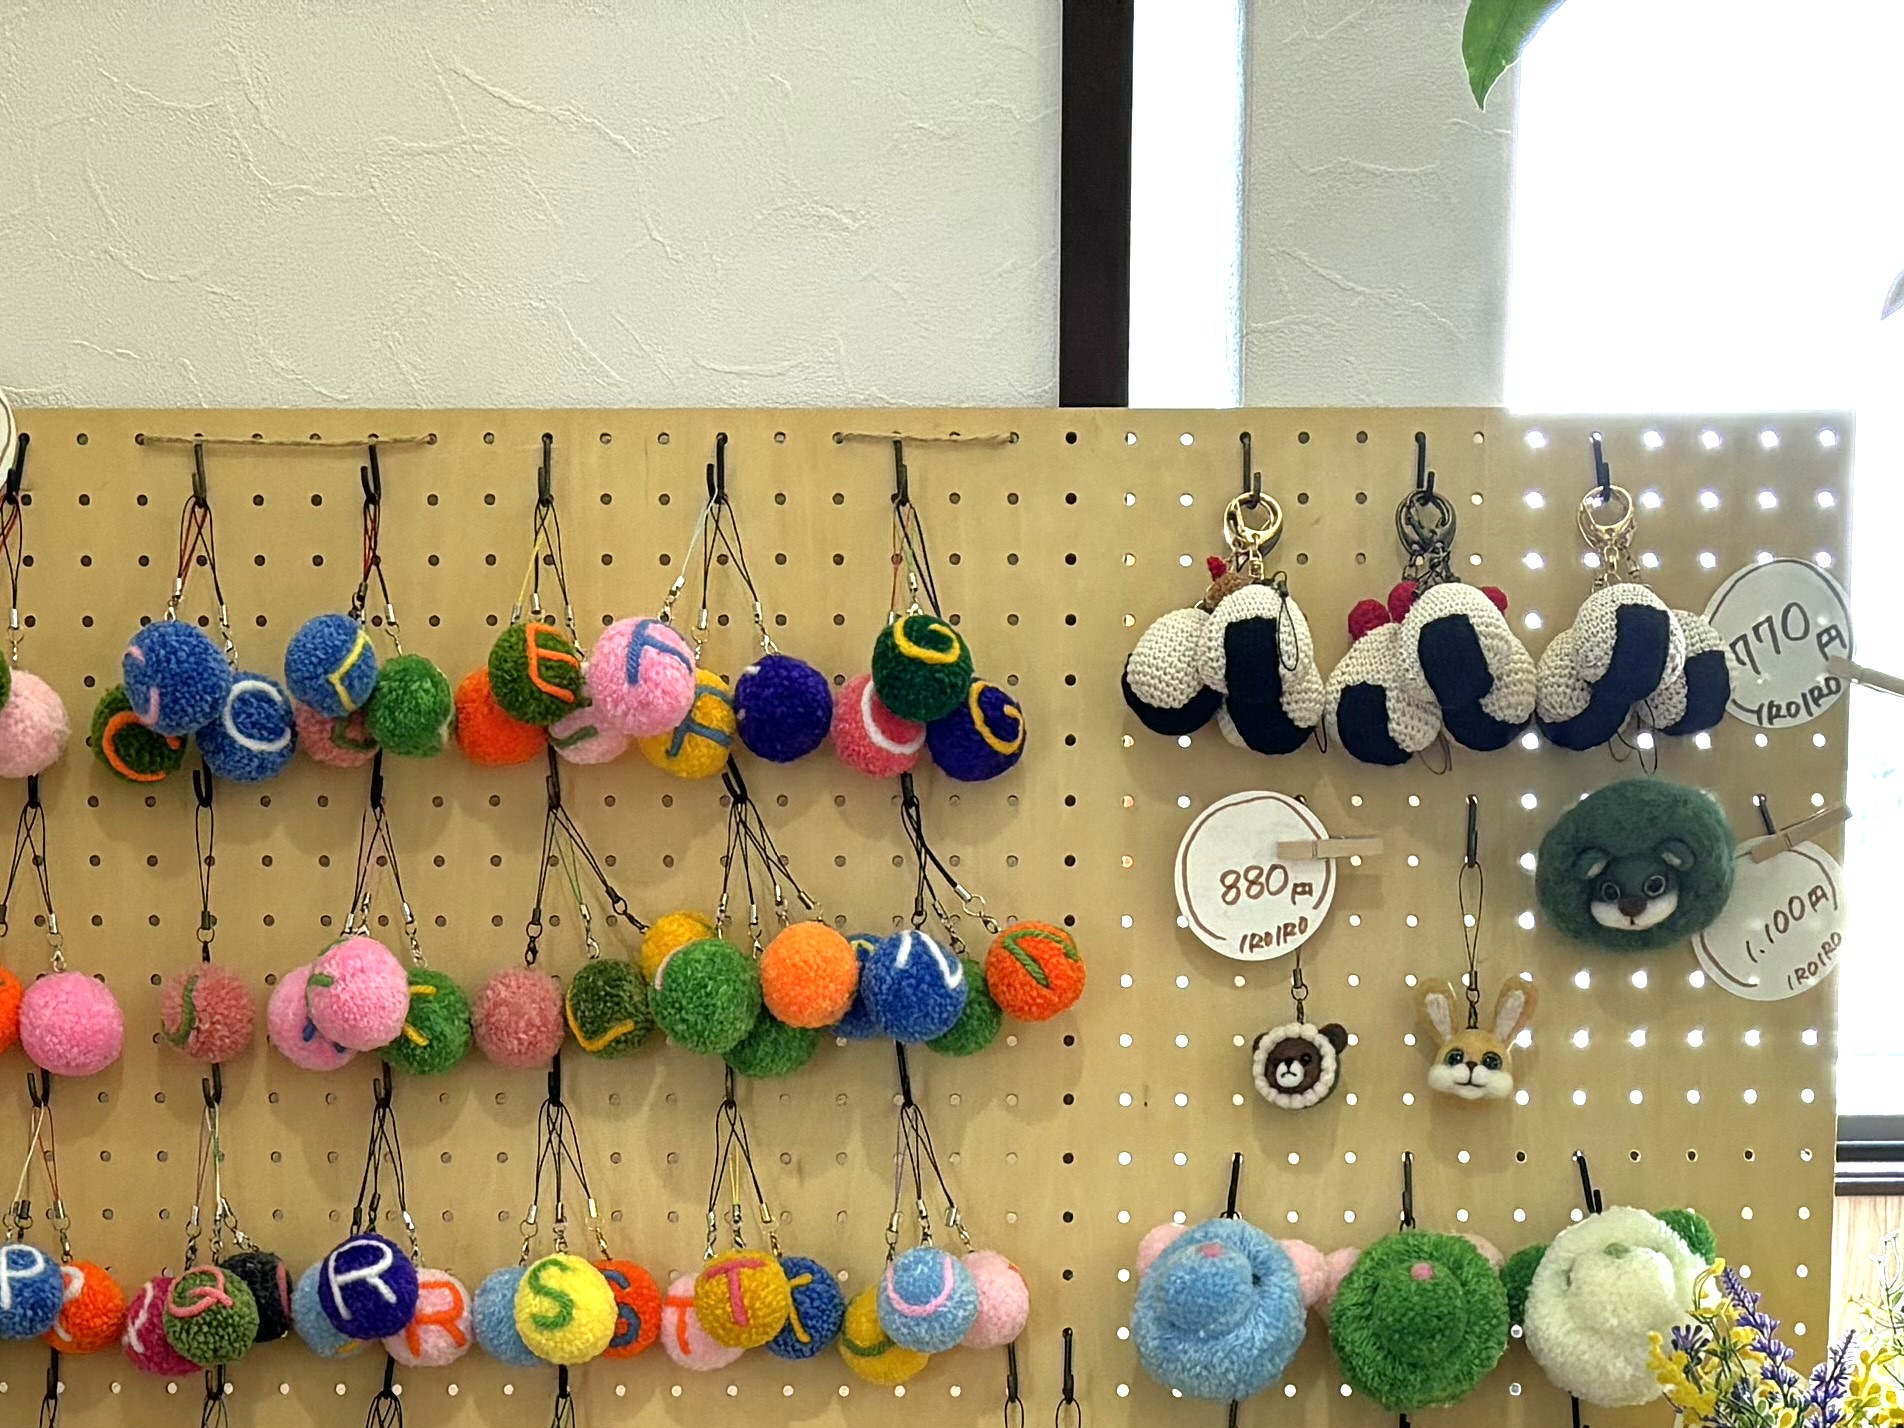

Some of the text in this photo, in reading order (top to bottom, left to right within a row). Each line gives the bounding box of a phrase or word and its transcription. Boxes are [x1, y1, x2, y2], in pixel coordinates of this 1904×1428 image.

[526, 622, 580, 704] E
[328, 1239, 397, 1321] R
[405, 1280, 467, 1358] R
[528, 1258, 575, 1331] S
[706, 1258, 768, 1328] T
